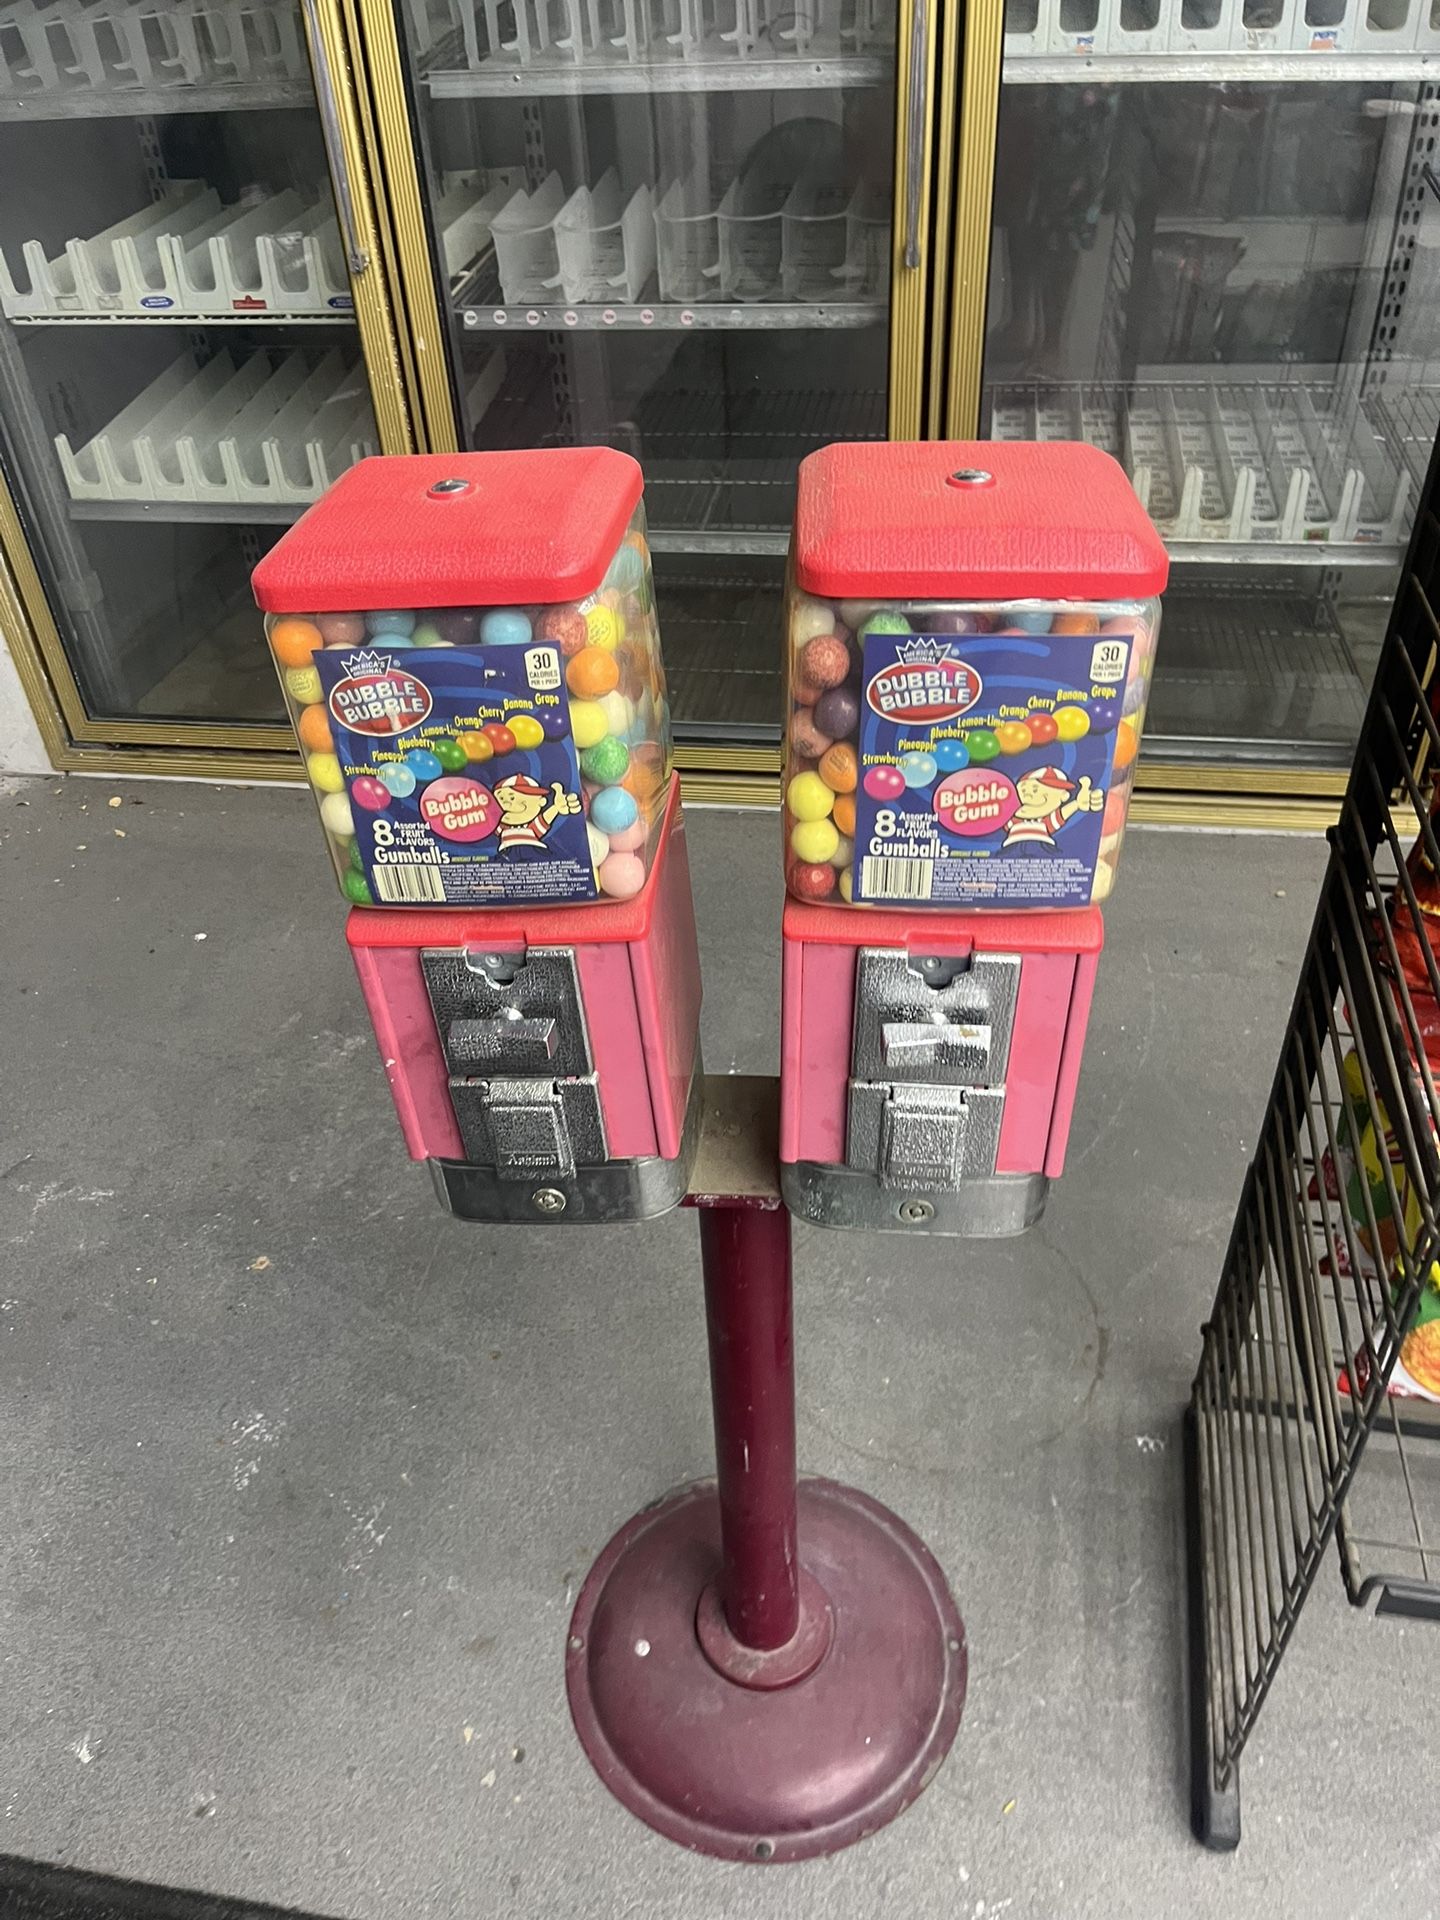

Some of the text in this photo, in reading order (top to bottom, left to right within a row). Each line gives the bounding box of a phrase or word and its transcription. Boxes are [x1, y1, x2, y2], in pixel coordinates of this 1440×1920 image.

[1101, 646, 1120, 662] 30
[350, 661, 385, 672] AMERICA'S
[533, 653, 551, 670] 30
[529, 670, 558, 678] CALORIES
[876, 671, 968, 695] DUBBLE
[335, 681, 417, 707] DUBBLE
[1056, 690, 1088, 702] Banana
[1091, 685, 1117, 699] Grape
[503, 697, 534, 711] Banana
[535, 693, 560, 707] Grape
[880, 688, 971, 712] BUBBLE
[1028, 697, 1055, 711] Cherry
[344, 698, 425, 724] BUBBLE
[478, 706, 505, 721] Cherry
[999, 706, 1029, 719] Orange
[455, 715, 484, 727] Orange
[957, 716, 1006, 729] Lemon-Lime
[420, 724, 465, 738] Lemon-Lime
[930, 727, 970, 741] Blueberry
[398, 736, 436, 752] Blueberry
[898, 739, 937, 753] Pineapple
[372, 749, 408, 763] Pineapple
[862, 753, 908, 767] Strawberry
[344, 765, 387, 778] Strawberry
[940, 783, 1009, 808] Bubble
[425, 789, 489, 817] Bubble
[443, 809, 487, 831] Gum
[899, 812, 939, 822] Assorted
[953, 803, 999, 824] Gum
[393, 821, 431, 831] Assorted
[874, 810, 896, 838] 8
[905, 820, 931, 830] FRUIT
[373, 820, 395, 846] 8
[400, 829, 425, 839] FRUIT
[895, 828, 938, 838] FLAVORS
[395, 837, 435, 846] FLAVORS
[869, 837, 949, 858] Gumballs
[374, 846, 450, 864] Gumballs
